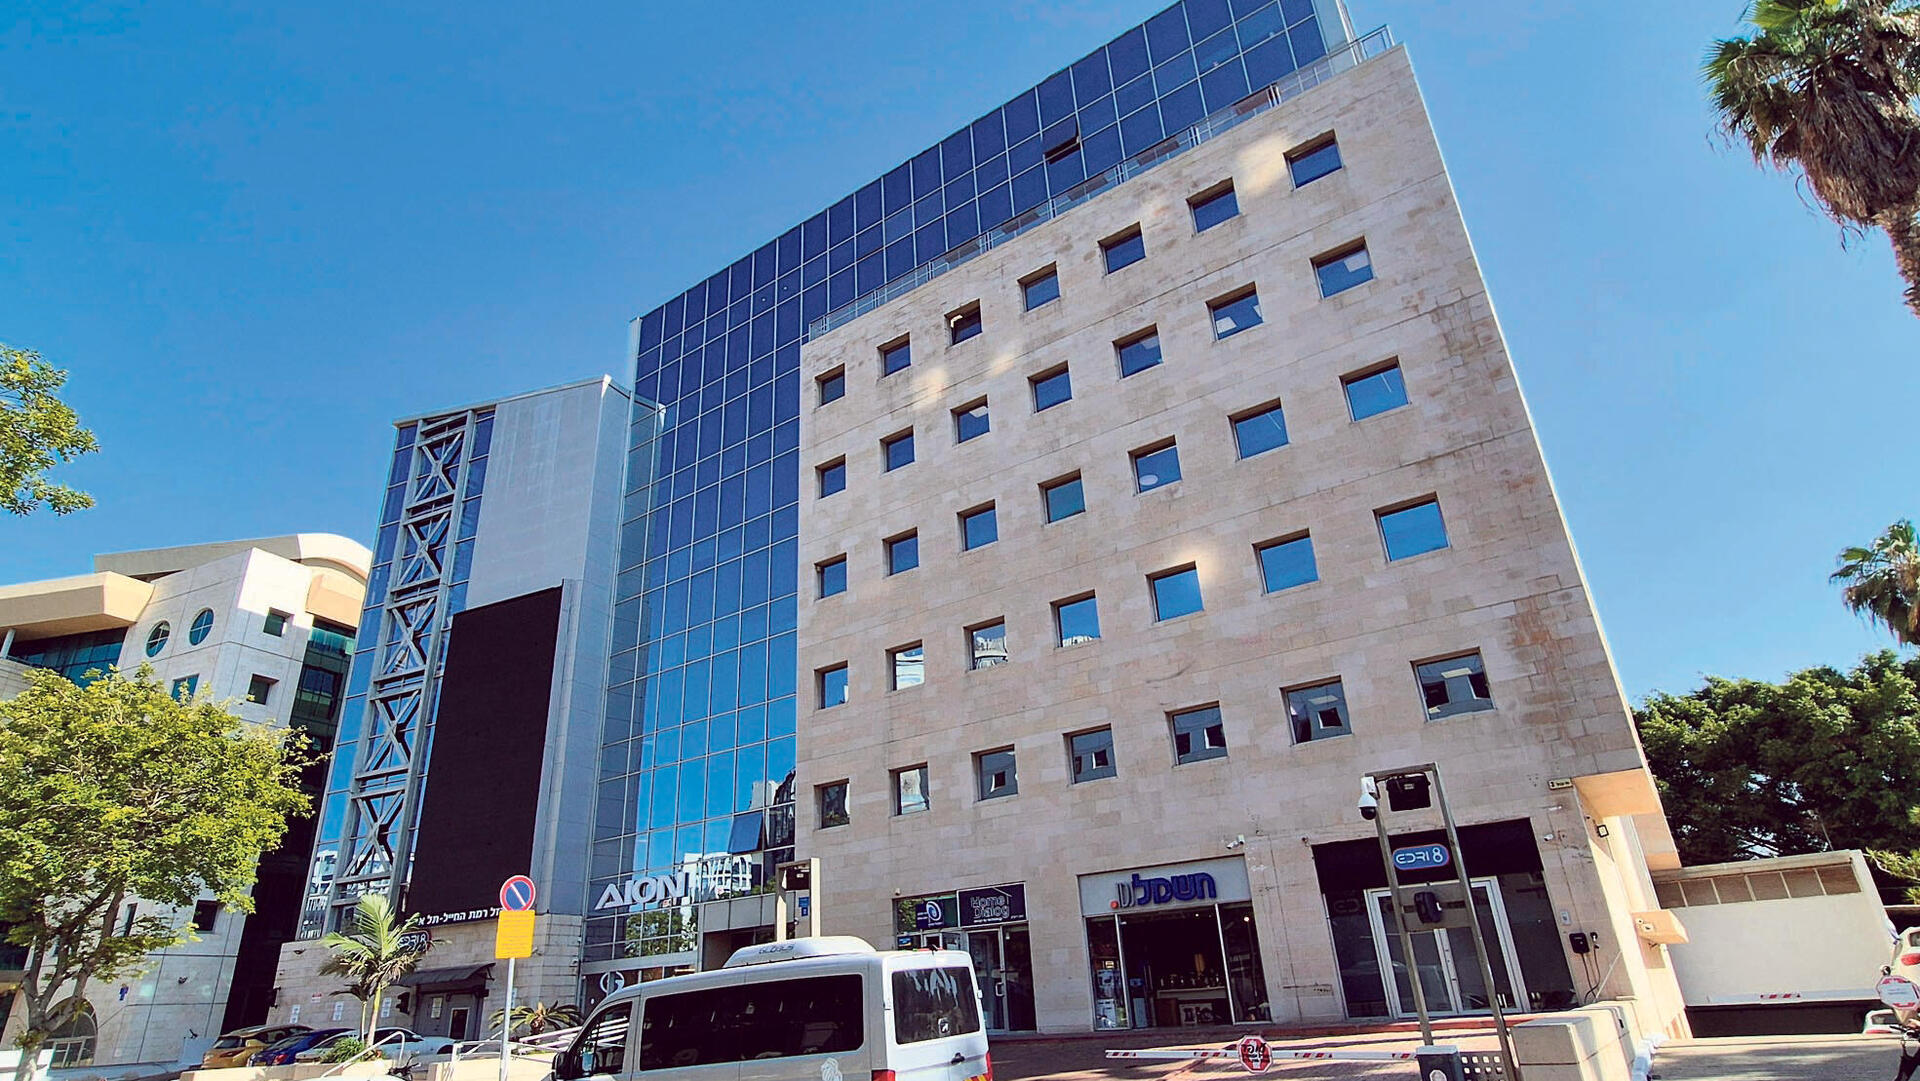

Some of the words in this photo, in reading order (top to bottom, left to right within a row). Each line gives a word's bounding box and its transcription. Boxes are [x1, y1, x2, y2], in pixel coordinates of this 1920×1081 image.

[1395, 851, 1430, 864] EDRI
[1432, 847, 1444, 863] 8
[594, 872, 689, 910] AION
[970, 895, 1006, 908] Home
[468, 909, 488, 920] רמת
[973, 905, 1010, 919] Dialog
